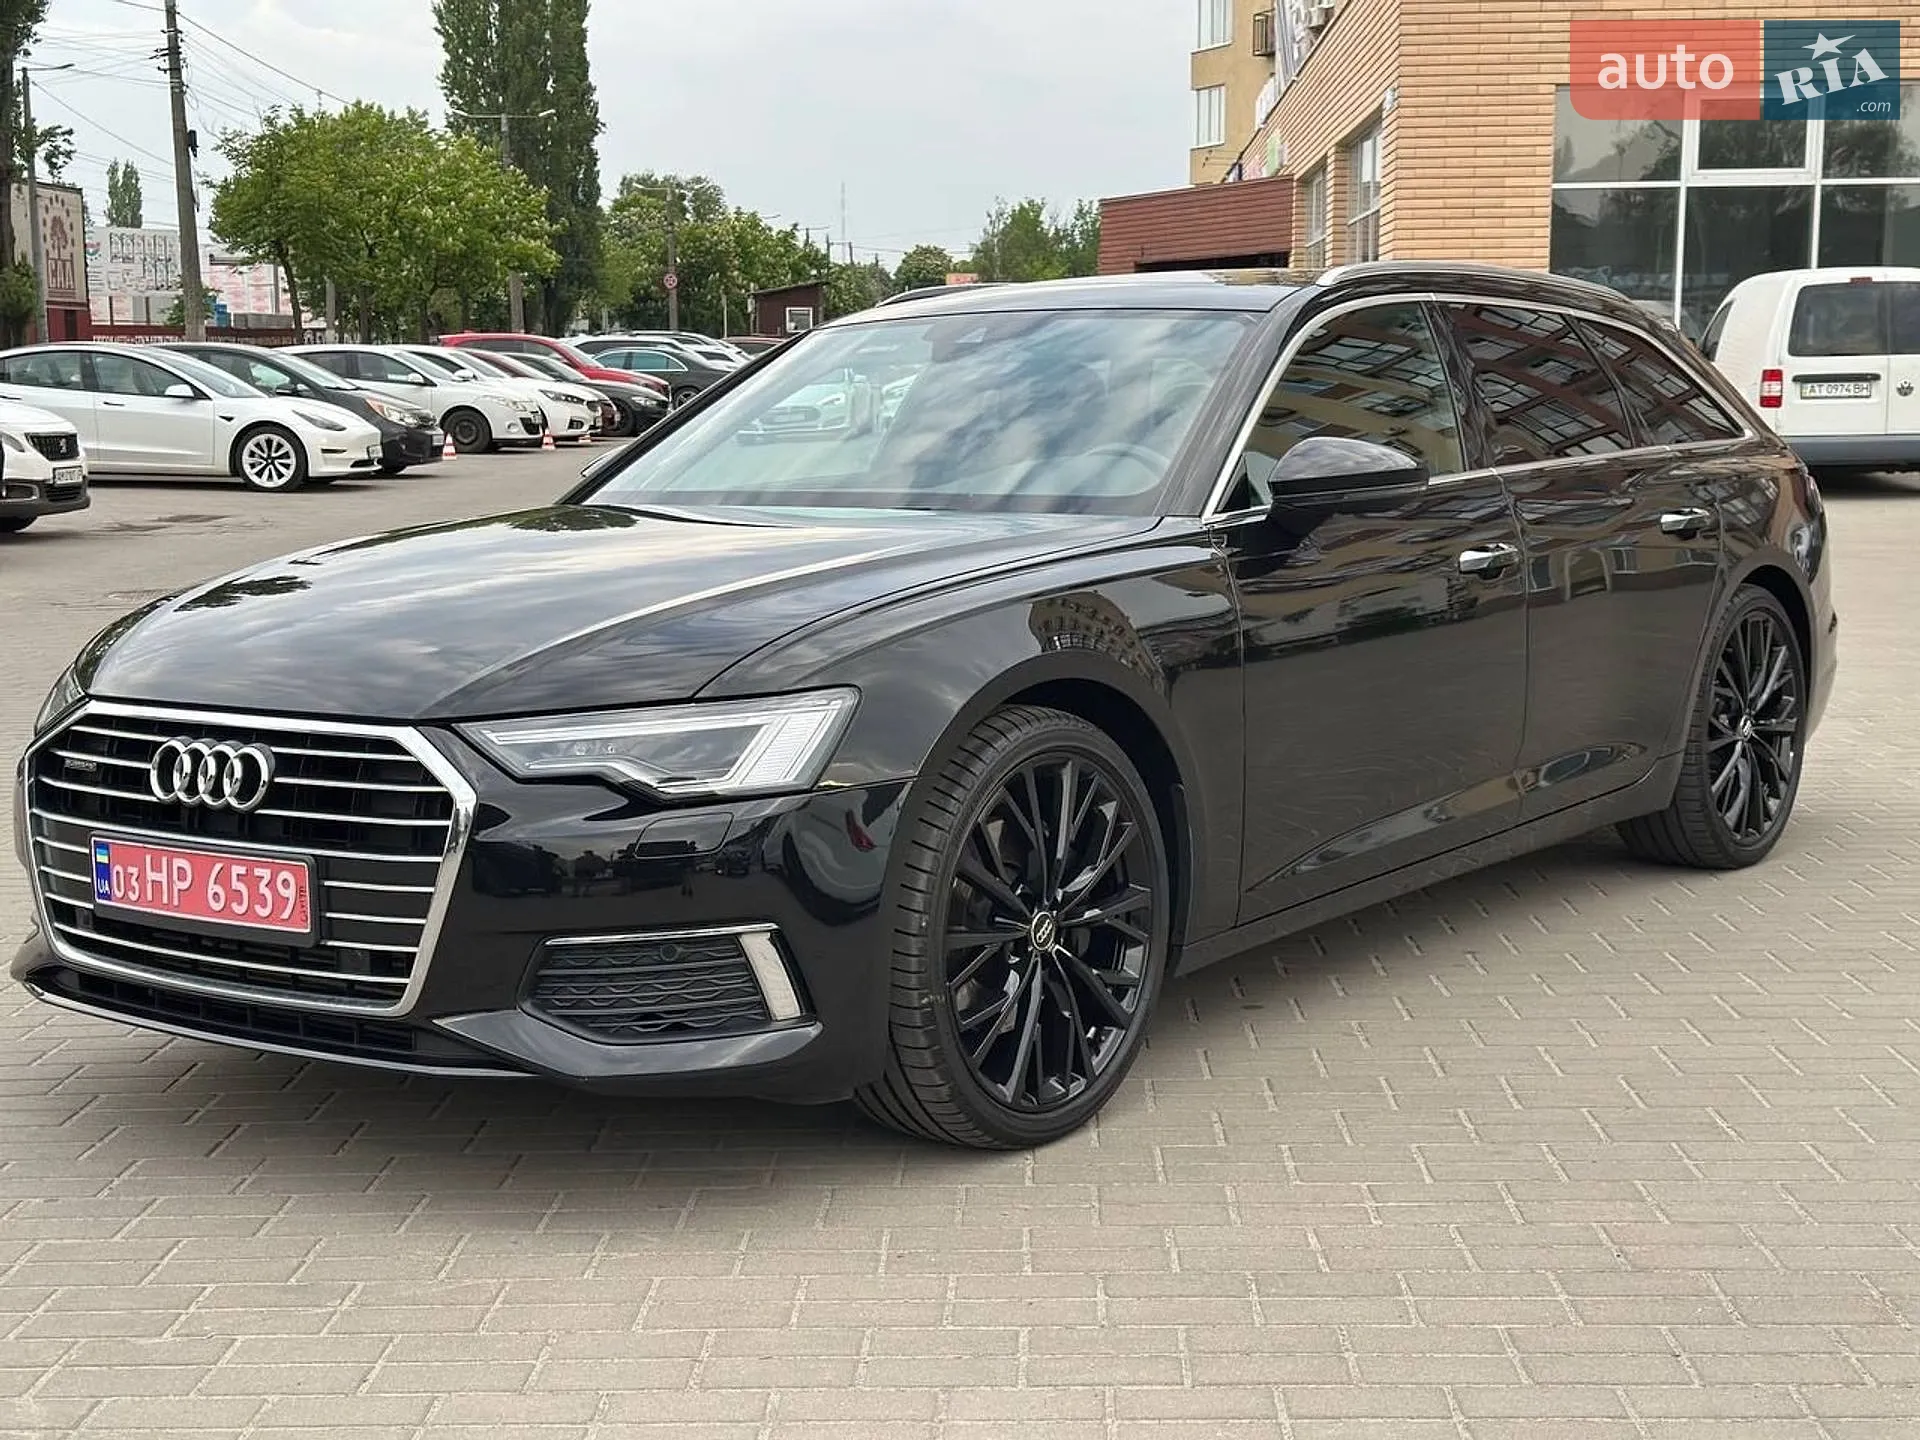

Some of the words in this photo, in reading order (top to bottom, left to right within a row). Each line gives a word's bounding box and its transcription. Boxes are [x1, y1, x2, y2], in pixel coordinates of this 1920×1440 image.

[1825, 383, 1852, 394] 0974
[97, 878, 111, 895] UA
[207, 862, 297, 920] 6539
